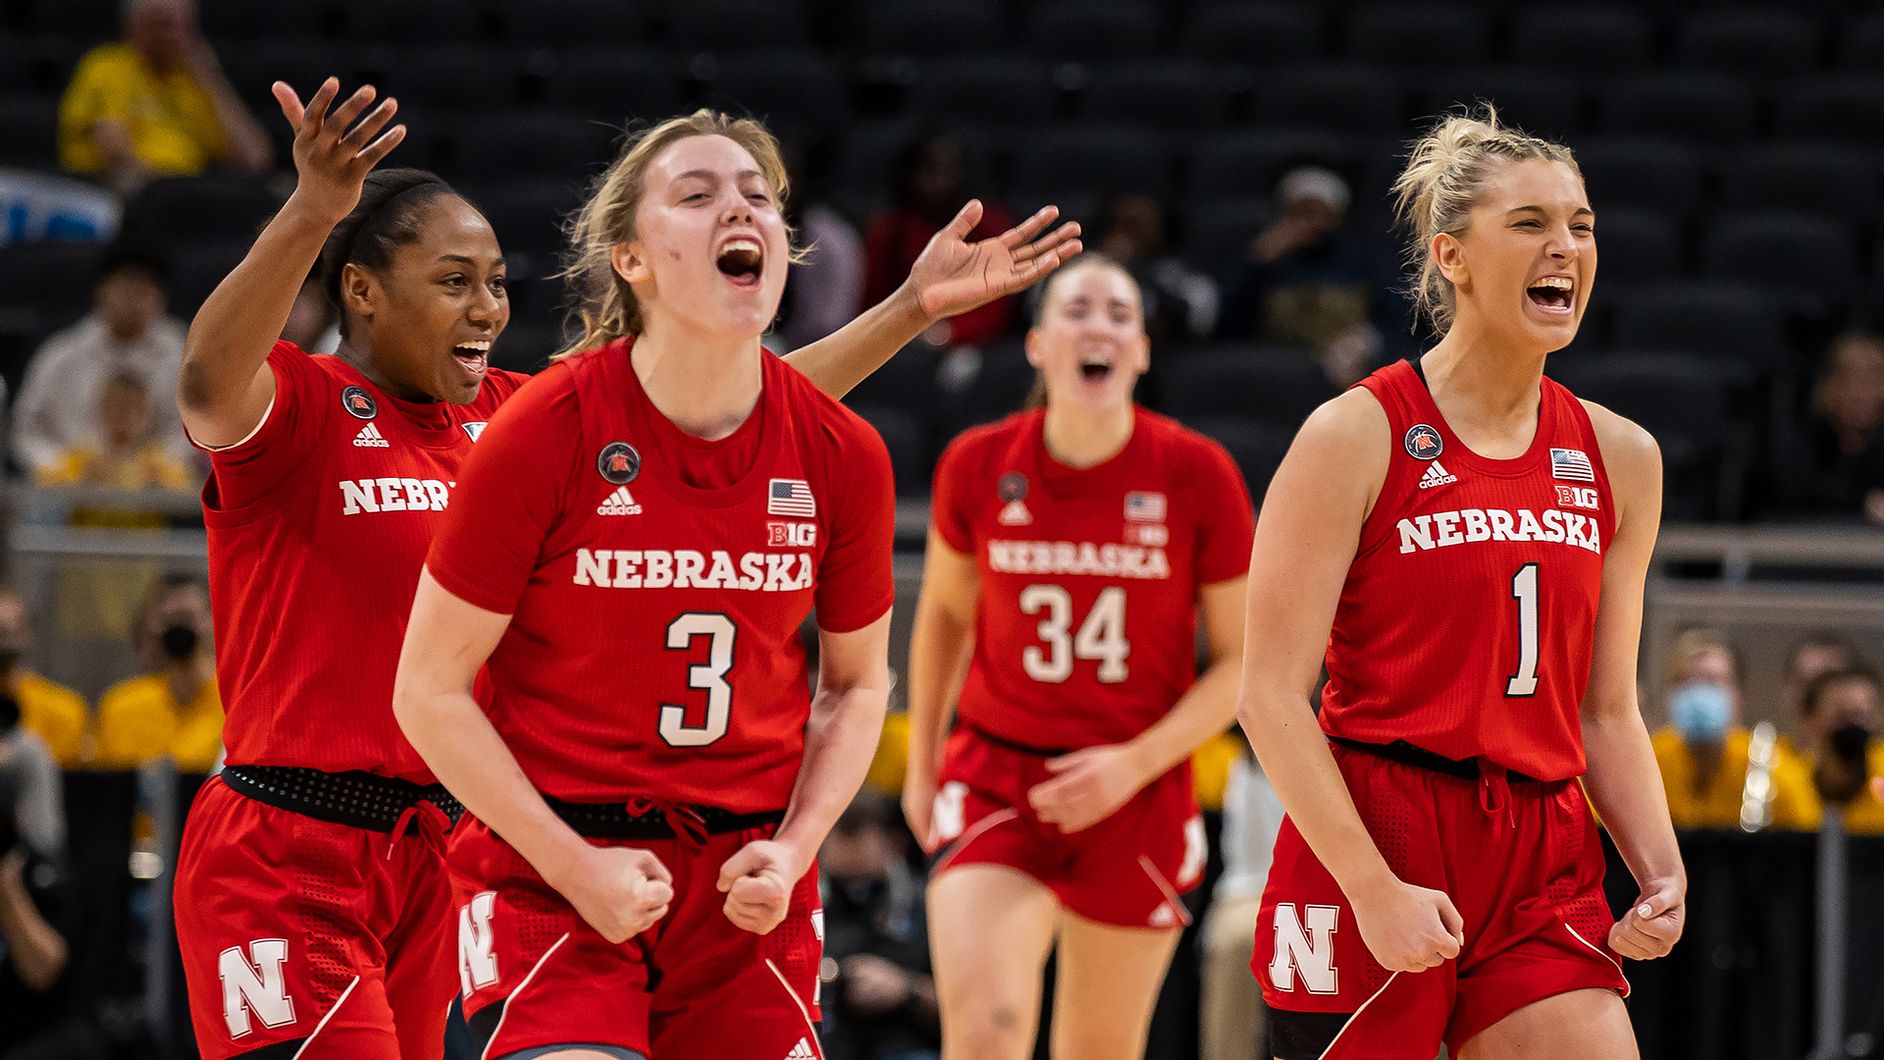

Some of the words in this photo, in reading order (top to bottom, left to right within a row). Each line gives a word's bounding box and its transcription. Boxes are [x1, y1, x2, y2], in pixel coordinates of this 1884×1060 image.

[353, 438, 390, 448] adidas
[1417, 435, 1433, 450] N
[339, 477, 457, 516] NEBR
[1418, 474, 1458, 490] adidas
[597, 504, 643, 516] adidas
[1396, 508, 1601, 555] NEBRASKA
[573, 548, 814, 592] NEBRASKA
[987, 539, 1171, 580] NEBRASKA
[1018, 582, 1130, 684] 34
[1504, 562, 1541, 698] 1
[658, 611, 737, 748] 3
[458, 889, 499, 1000] N
[1269, 902, 1341, 996] N
[217, 938, 297, 1040] N
